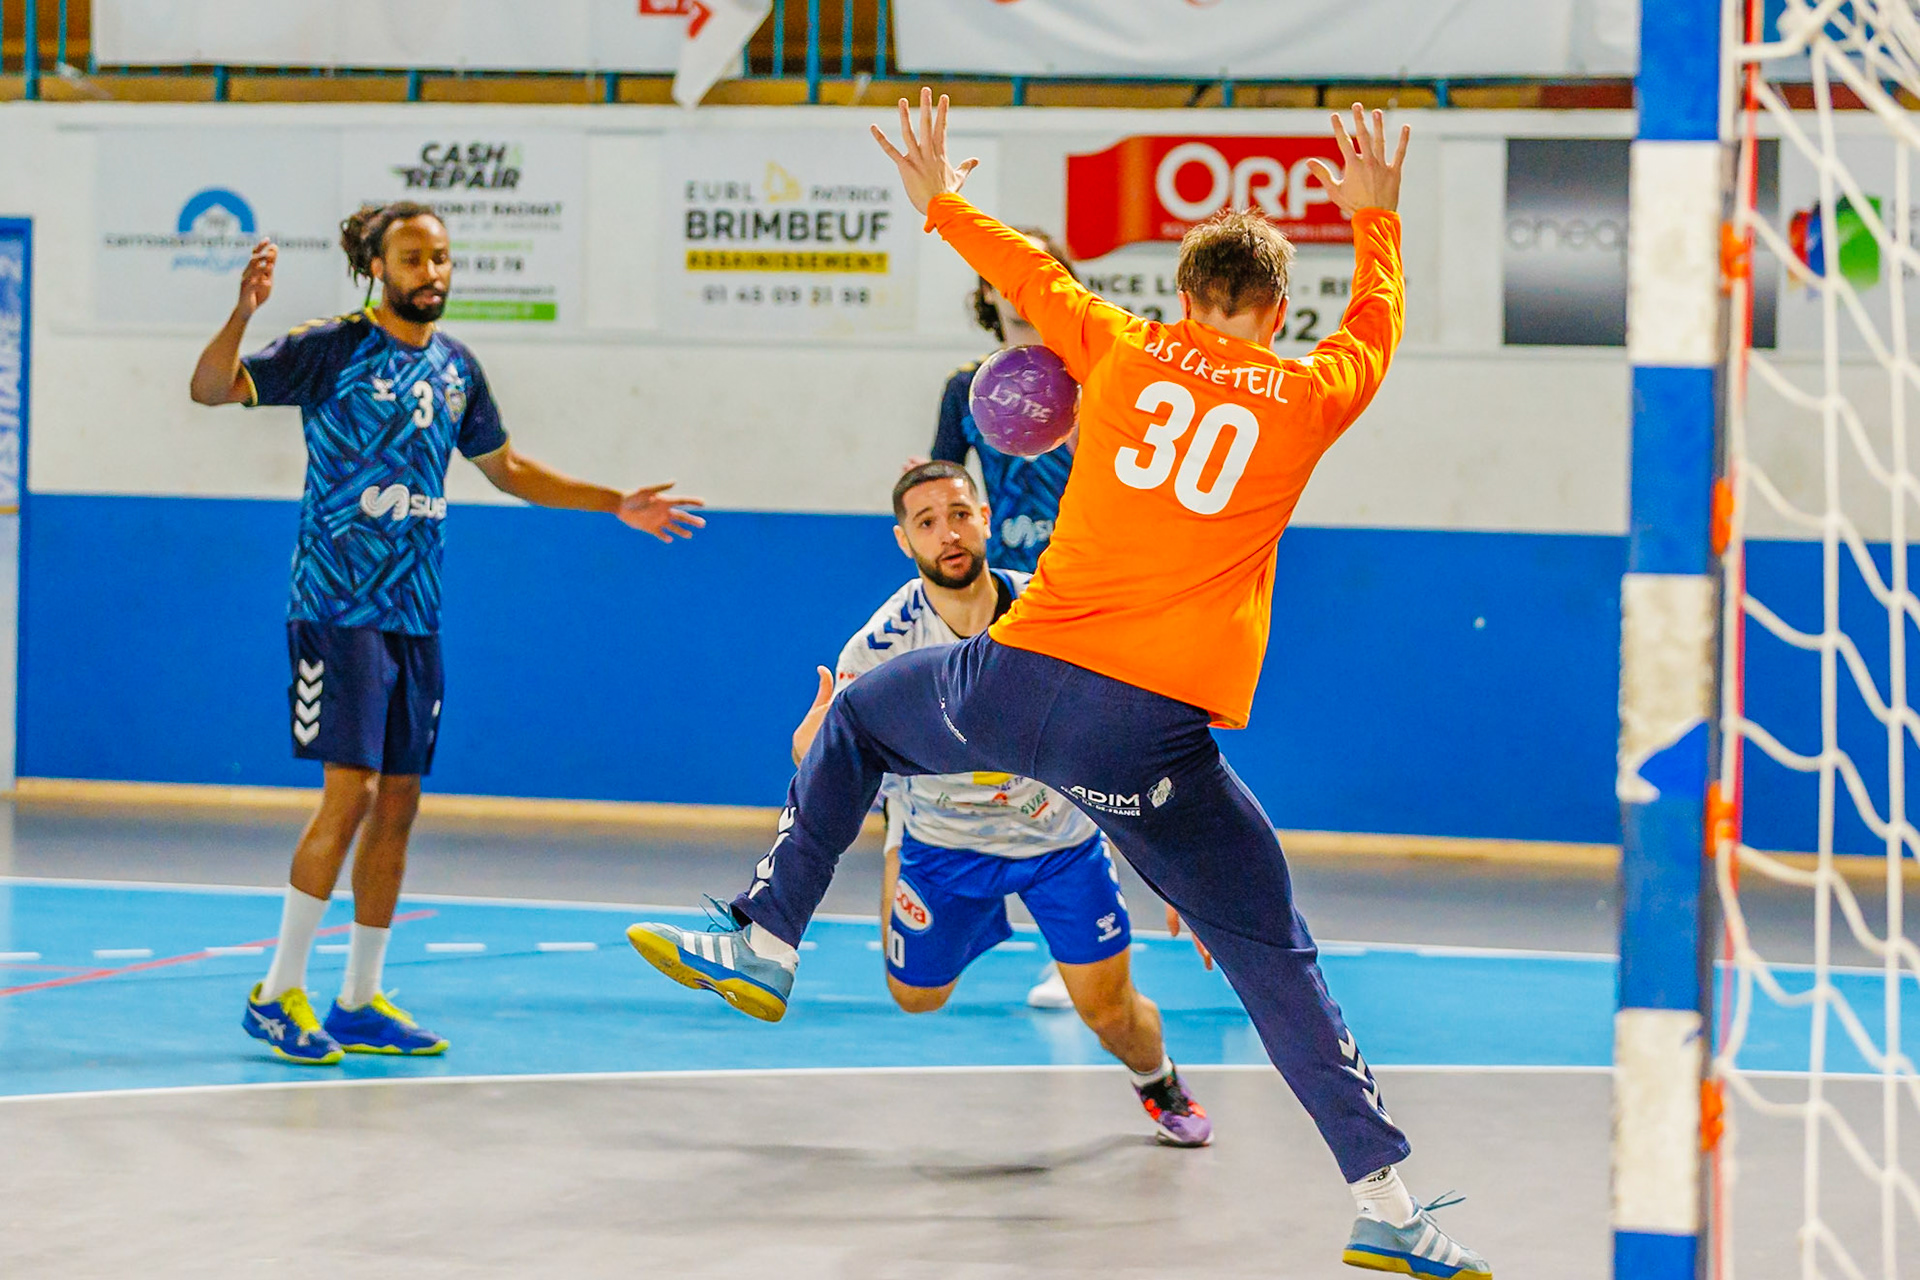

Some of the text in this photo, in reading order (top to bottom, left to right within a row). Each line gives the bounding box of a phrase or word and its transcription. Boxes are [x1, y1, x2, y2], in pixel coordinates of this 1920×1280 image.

[421, 141, 507, 165] CASH
[400, 166, 521, 189] REPAIR
[685, 180, 892, 204] EURL PATRICK
[1155, 142, 1350, 220] ORP
[685, 209, 890, 243] BRIMBEUF
[688, 253, 887, 269] ASSAINISSEMENT
[413, 380, 434, 429] 3
[1114, 380, 1260, 515] 30
